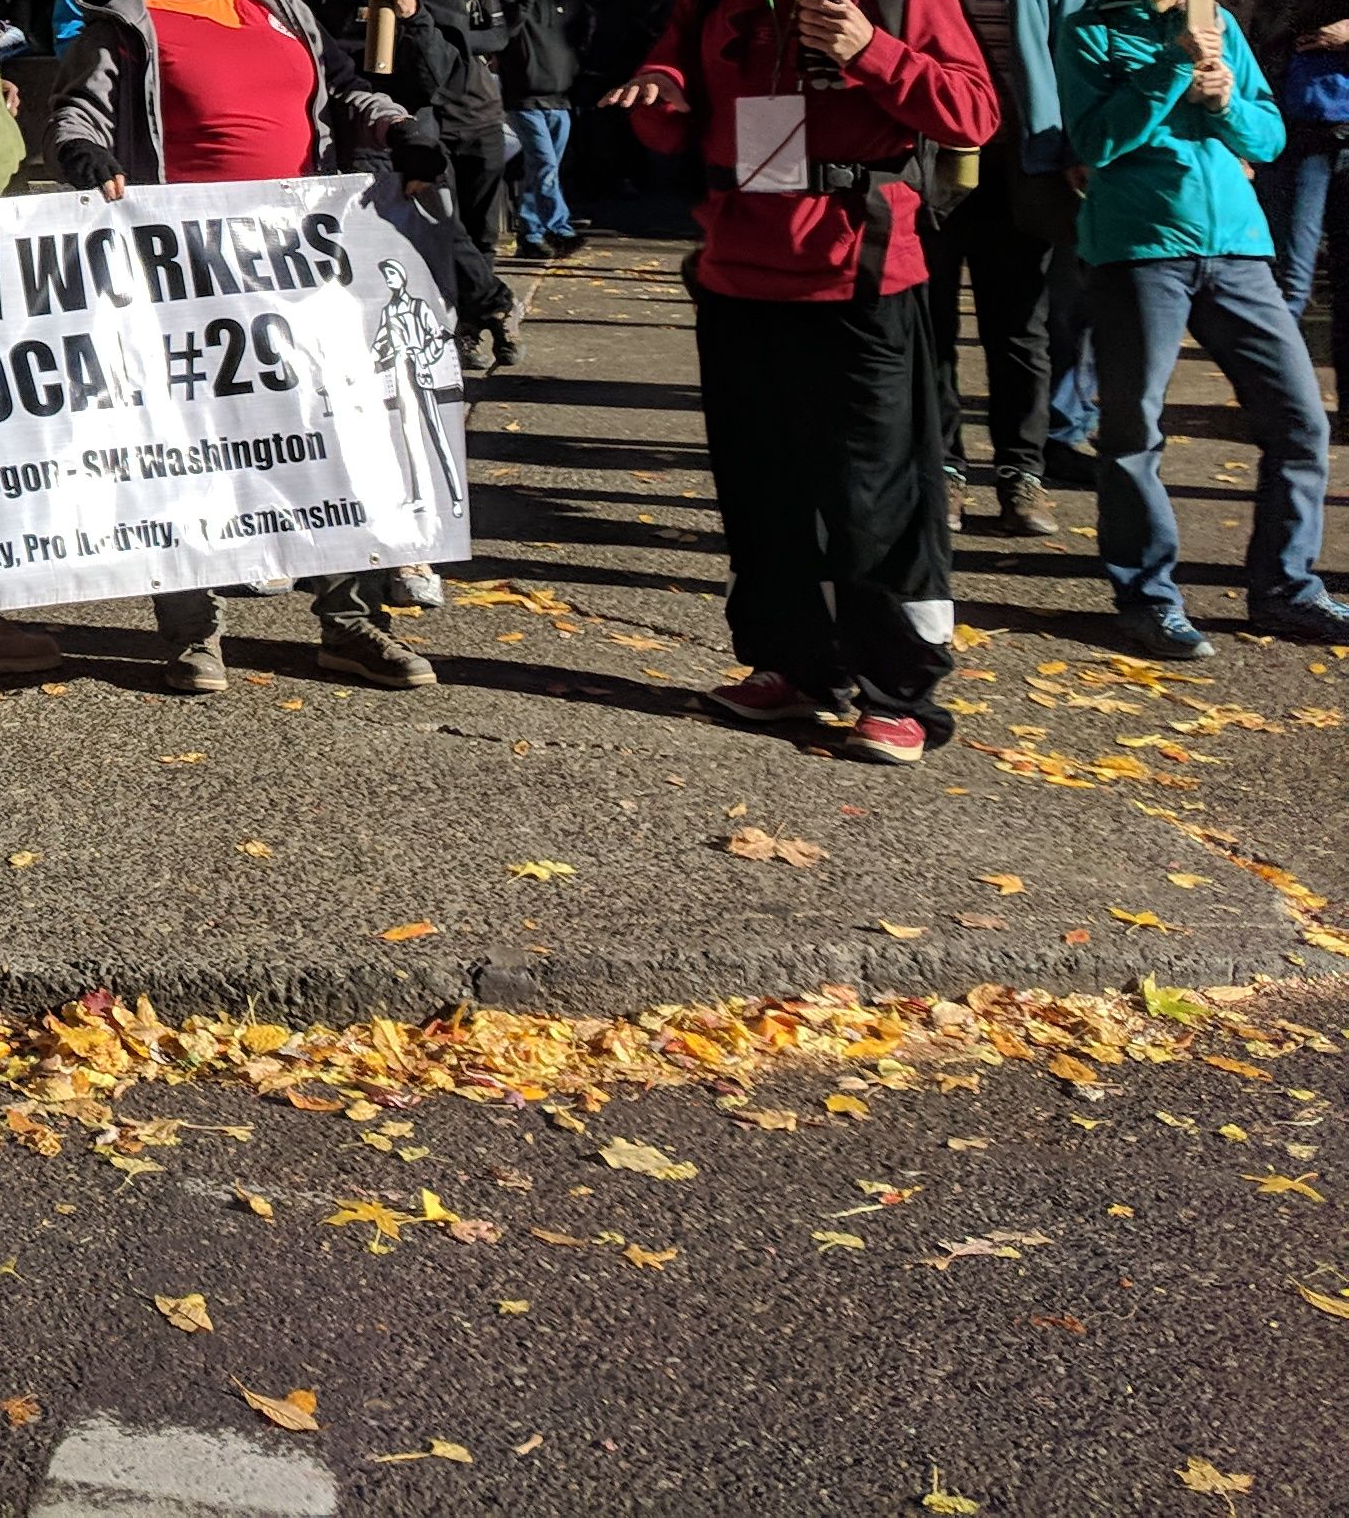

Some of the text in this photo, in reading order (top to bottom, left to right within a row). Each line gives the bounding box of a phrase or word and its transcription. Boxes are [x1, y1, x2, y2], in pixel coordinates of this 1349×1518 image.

[14, 212, 354, 318] WORKERS
[162, 312, 300, 401] #29
[81, 446, 132, 484] SW
[134, 430, 328, 480] Washington
[22, 516, 180, 563] Proutivity,
[183, 497, 369, 544] tsmanship
